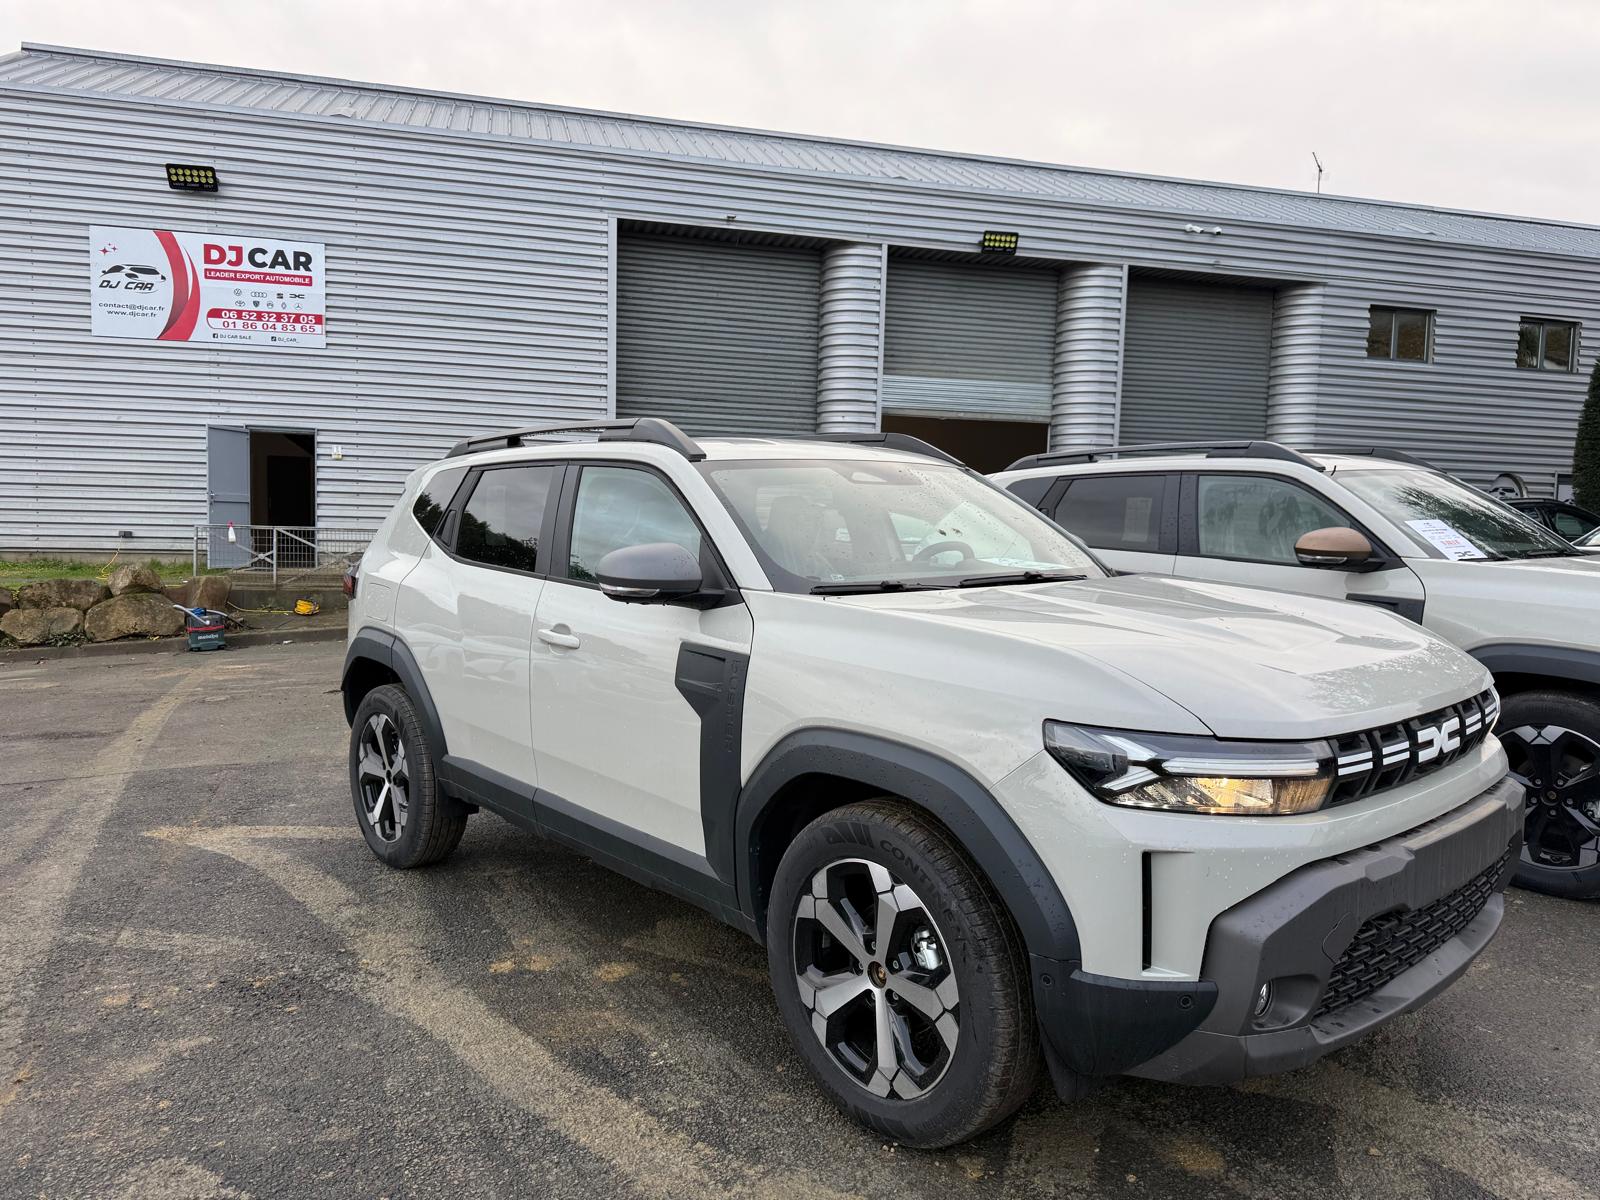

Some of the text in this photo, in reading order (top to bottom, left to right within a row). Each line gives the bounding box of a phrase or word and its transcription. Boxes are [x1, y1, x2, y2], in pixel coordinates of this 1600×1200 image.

[203, 243, 313, 272] DJ CAR
[206, 271, 310, 284] LEADER EXPORT AUTOMOBILE
[99, 280, 154, 291] DJ CAR
[98, 302, 165, 311] contact@djcar.fr
[107, 310, 158, 318] www.djcar.fr
[221, 310, 316, 324] 06 52 32 37 05
[222, 320, 316, 333] 01 86 04 83 65
